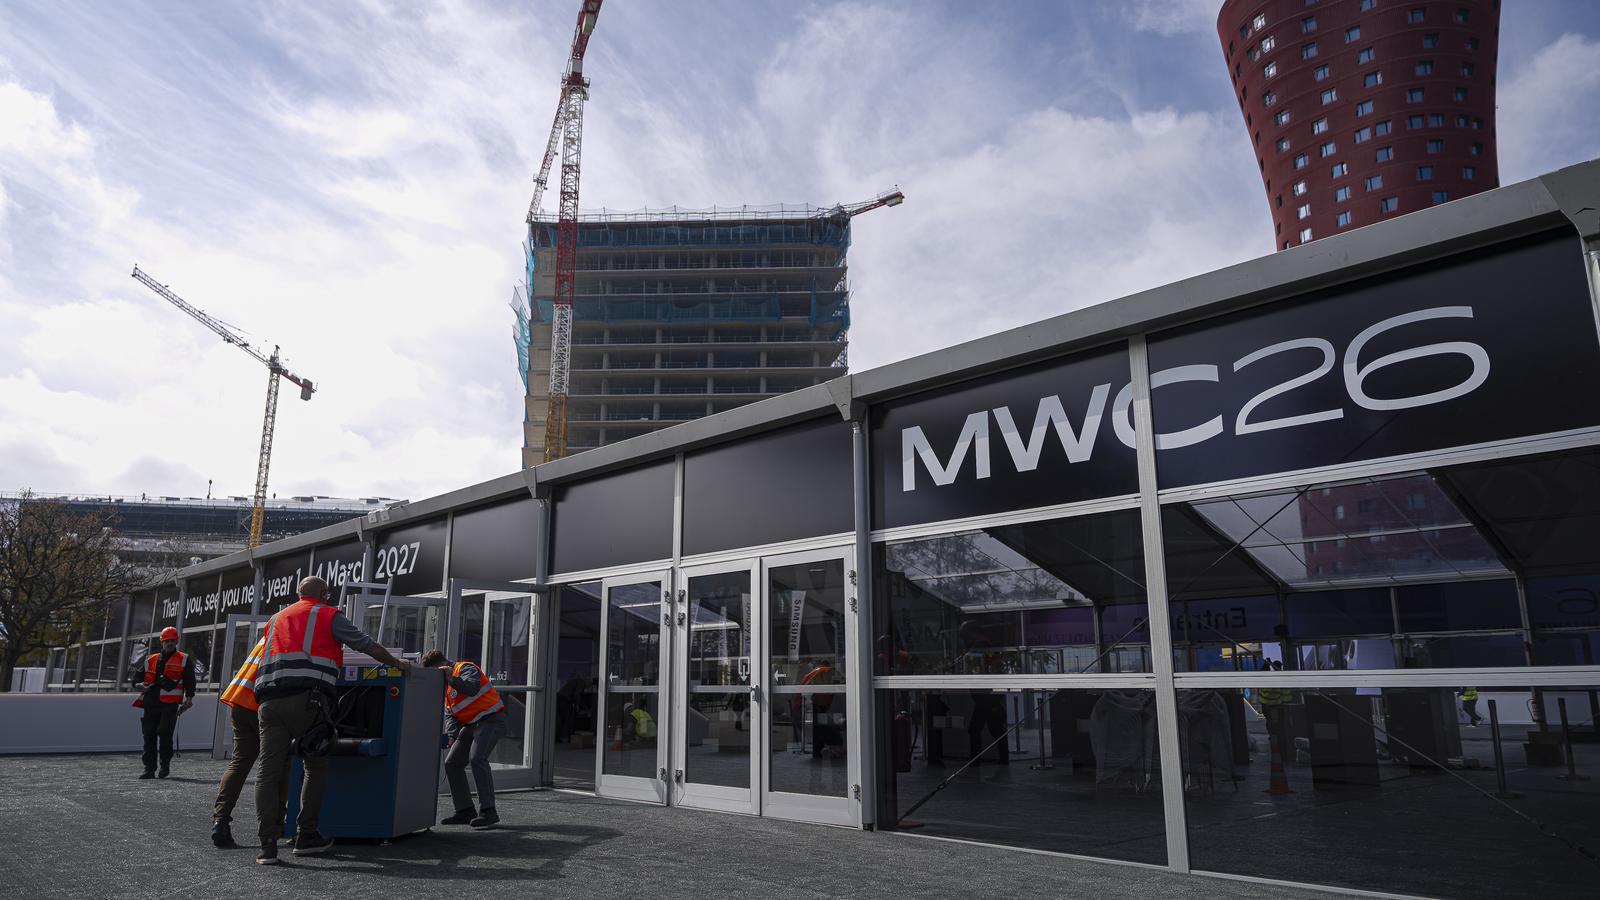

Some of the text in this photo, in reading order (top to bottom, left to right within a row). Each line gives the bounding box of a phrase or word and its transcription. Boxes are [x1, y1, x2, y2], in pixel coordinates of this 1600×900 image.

[902, 306, 1490, 492] MWC26
[162, 598, 180, 619] Than
[185, 596, 202, 619] you,
[205, 593, 220, 611] see
[221, 589, 240, 613] you
[241, 578, 265, 605] ne
[266, 575, 294, 604] year
[375, 542, 420, 579] 2027
